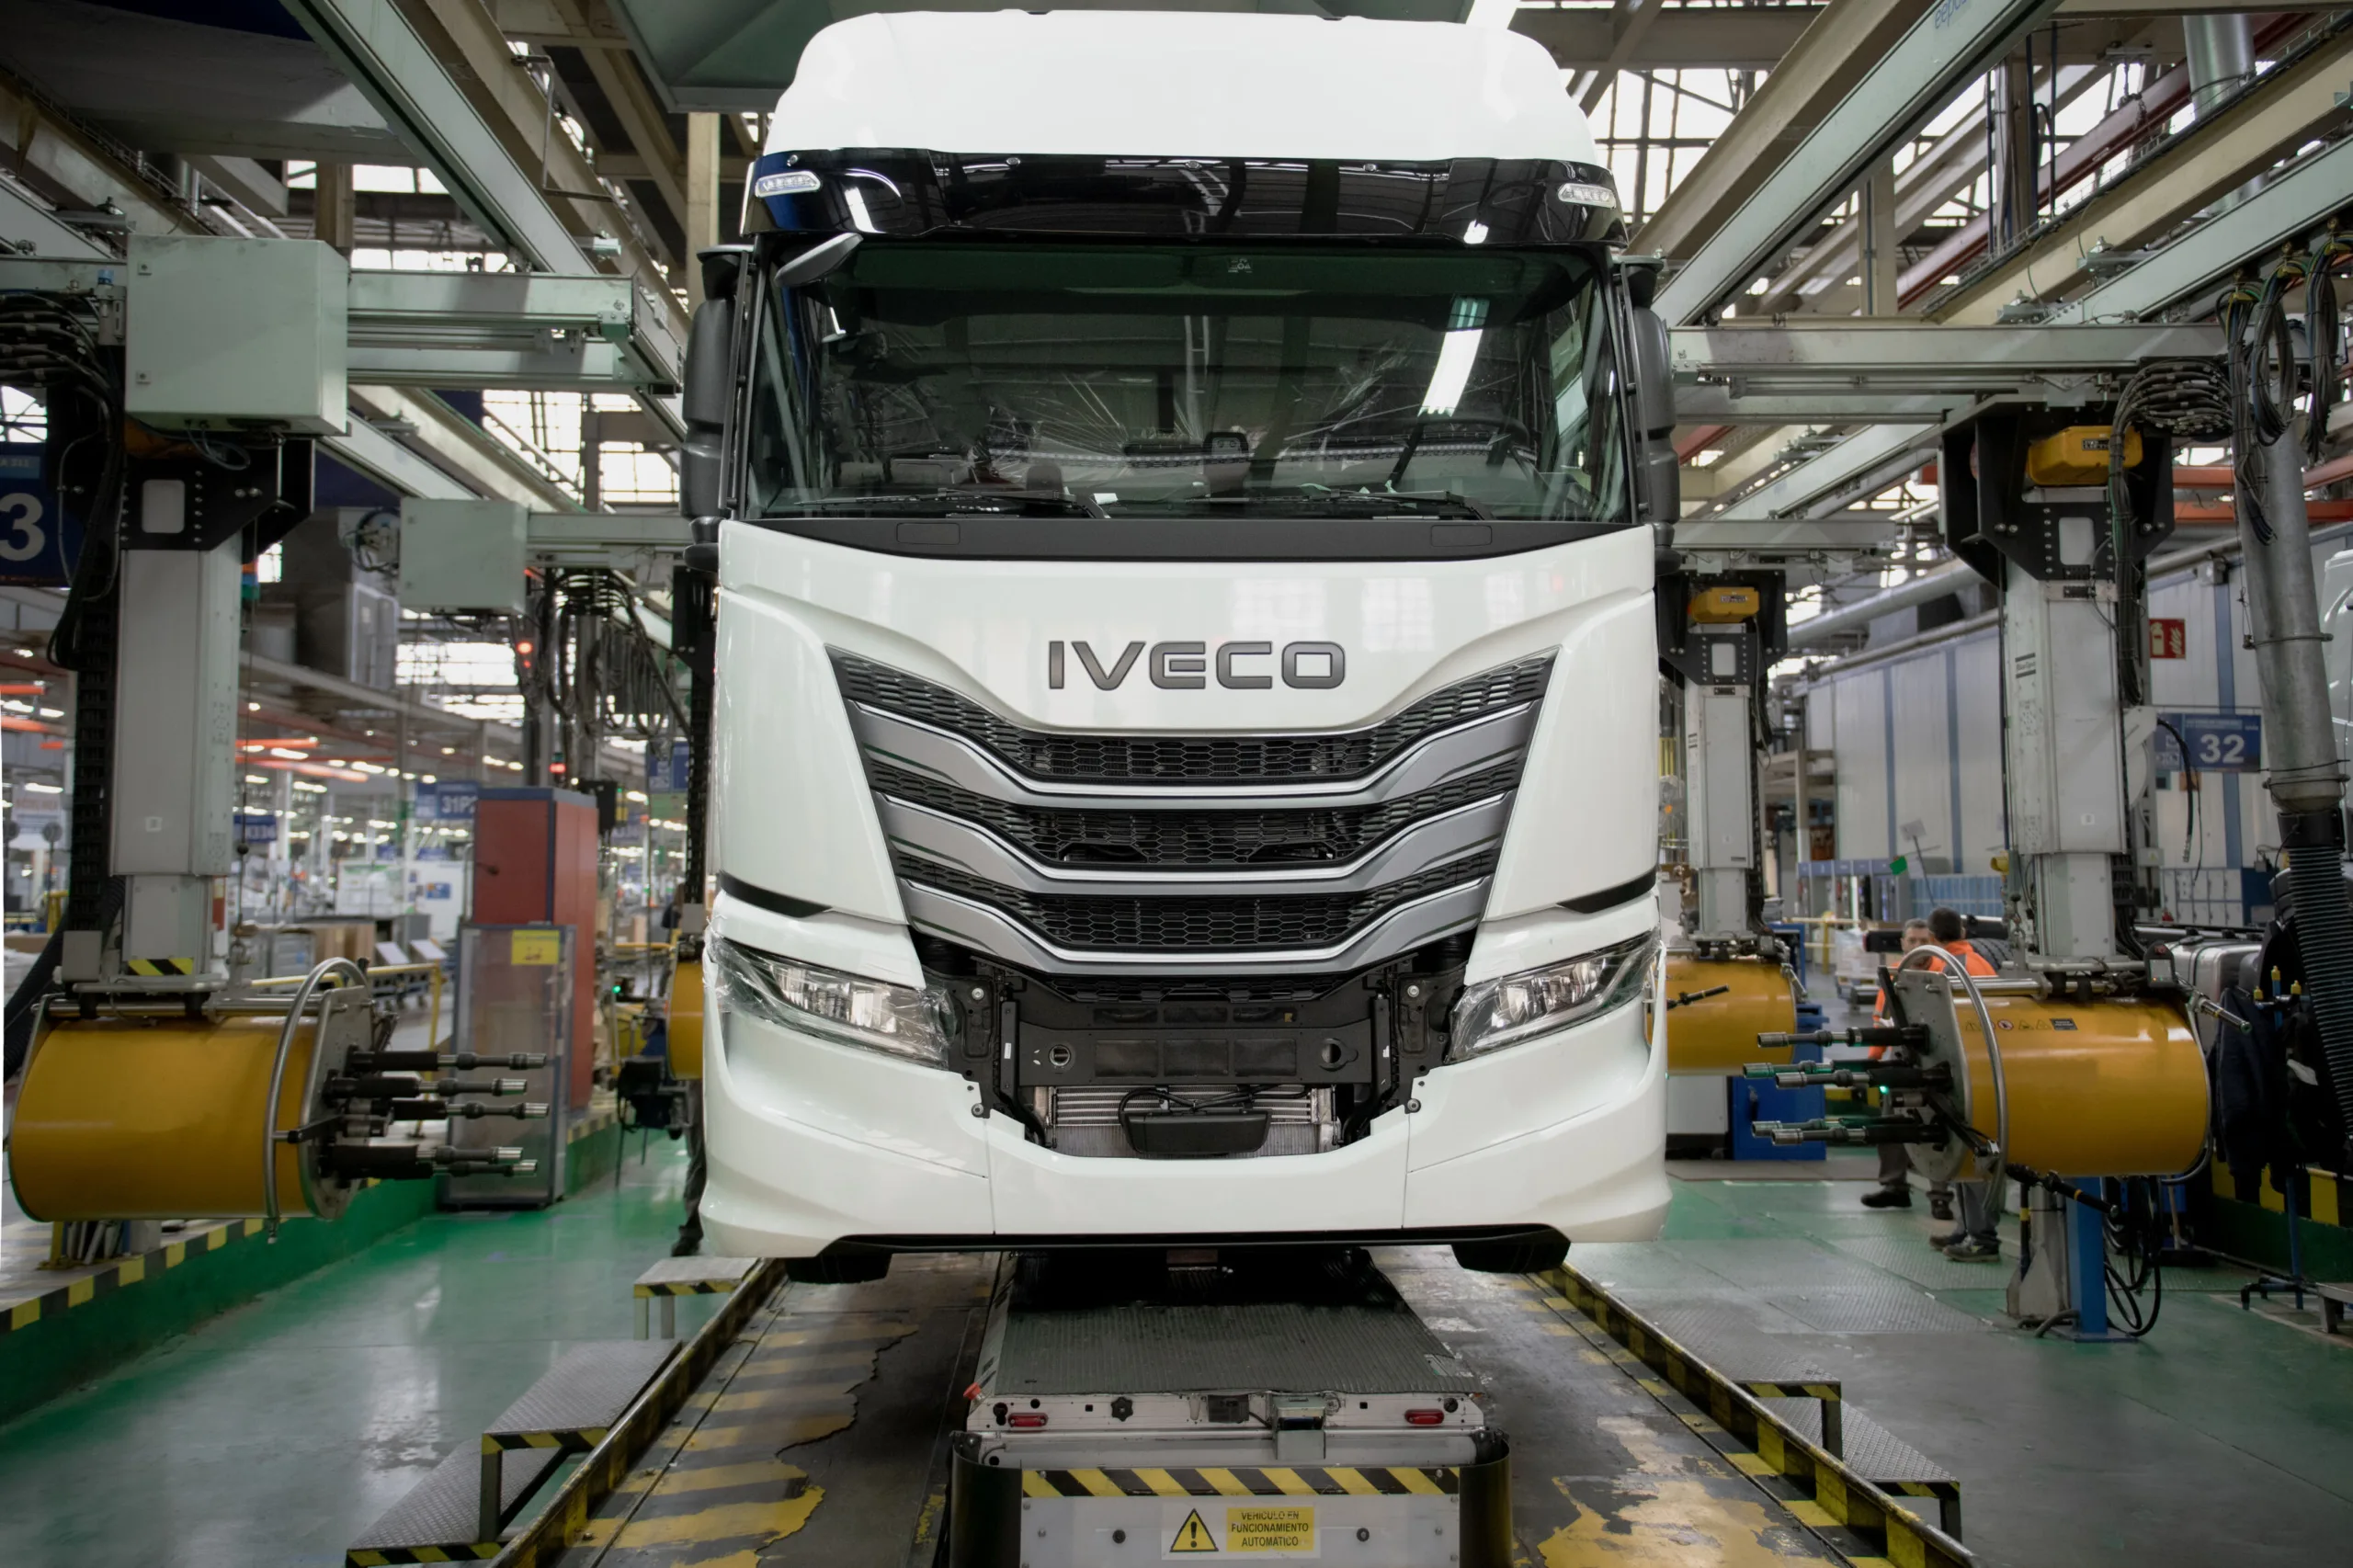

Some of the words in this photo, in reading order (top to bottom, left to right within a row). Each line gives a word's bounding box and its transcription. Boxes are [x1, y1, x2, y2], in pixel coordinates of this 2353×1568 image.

[1049, 641, 1346, 691] IVECO
[2200, 733, 2245, 764] 32
[1288, 1511, 1299, 1520] EN
[1231, 1522, 1309, 1533] FUNCIONAMIENTO
